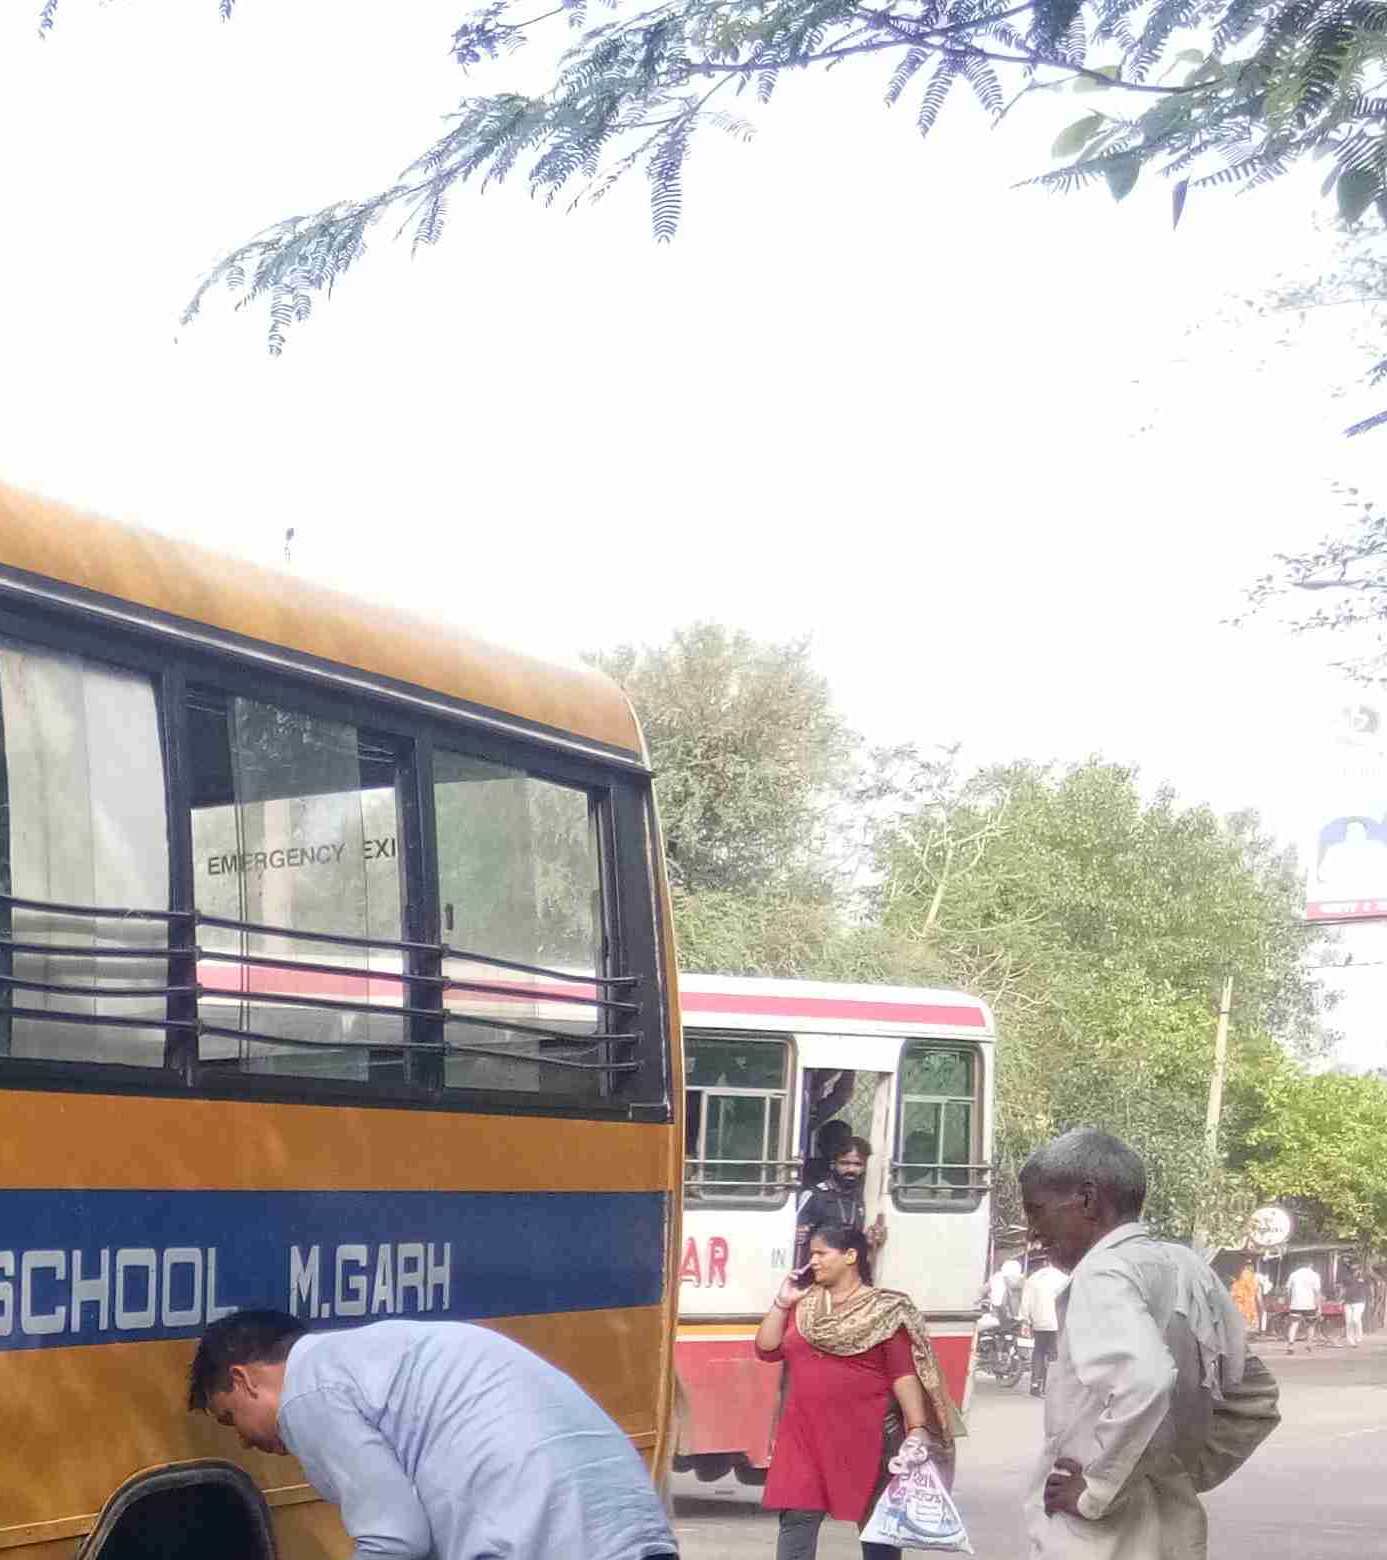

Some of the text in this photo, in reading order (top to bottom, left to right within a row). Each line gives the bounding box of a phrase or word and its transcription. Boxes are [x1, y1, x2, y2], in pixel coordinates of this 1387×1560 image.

[207, 838, 397, 876] EMERGENCY EXI
[288, 1241, 452, 1319] M.GARH
